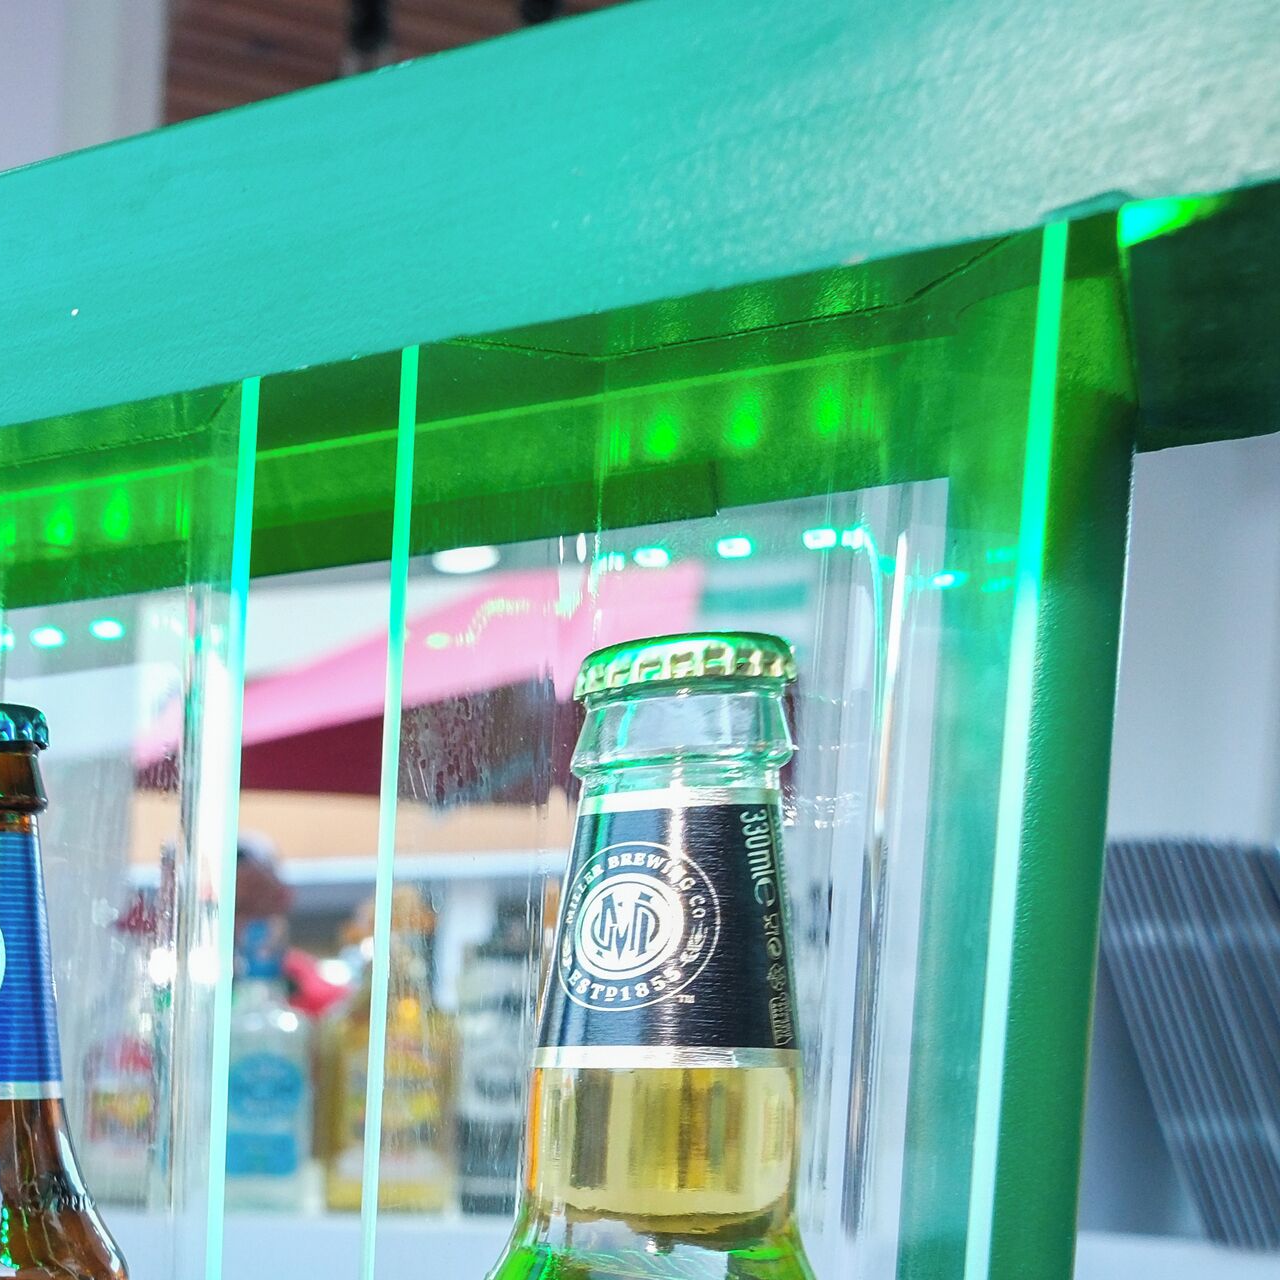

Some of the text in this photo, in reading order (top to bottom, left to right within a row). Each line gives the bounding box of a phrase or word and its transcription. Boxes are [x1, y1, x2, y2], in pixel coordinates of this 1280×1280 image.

[740, 808, 774, 882] 330ml
[566, 864, 604, 924] MILLER
[607, 853, 696, 891] BREWING
[620, 967, 682, 1001] 1855
